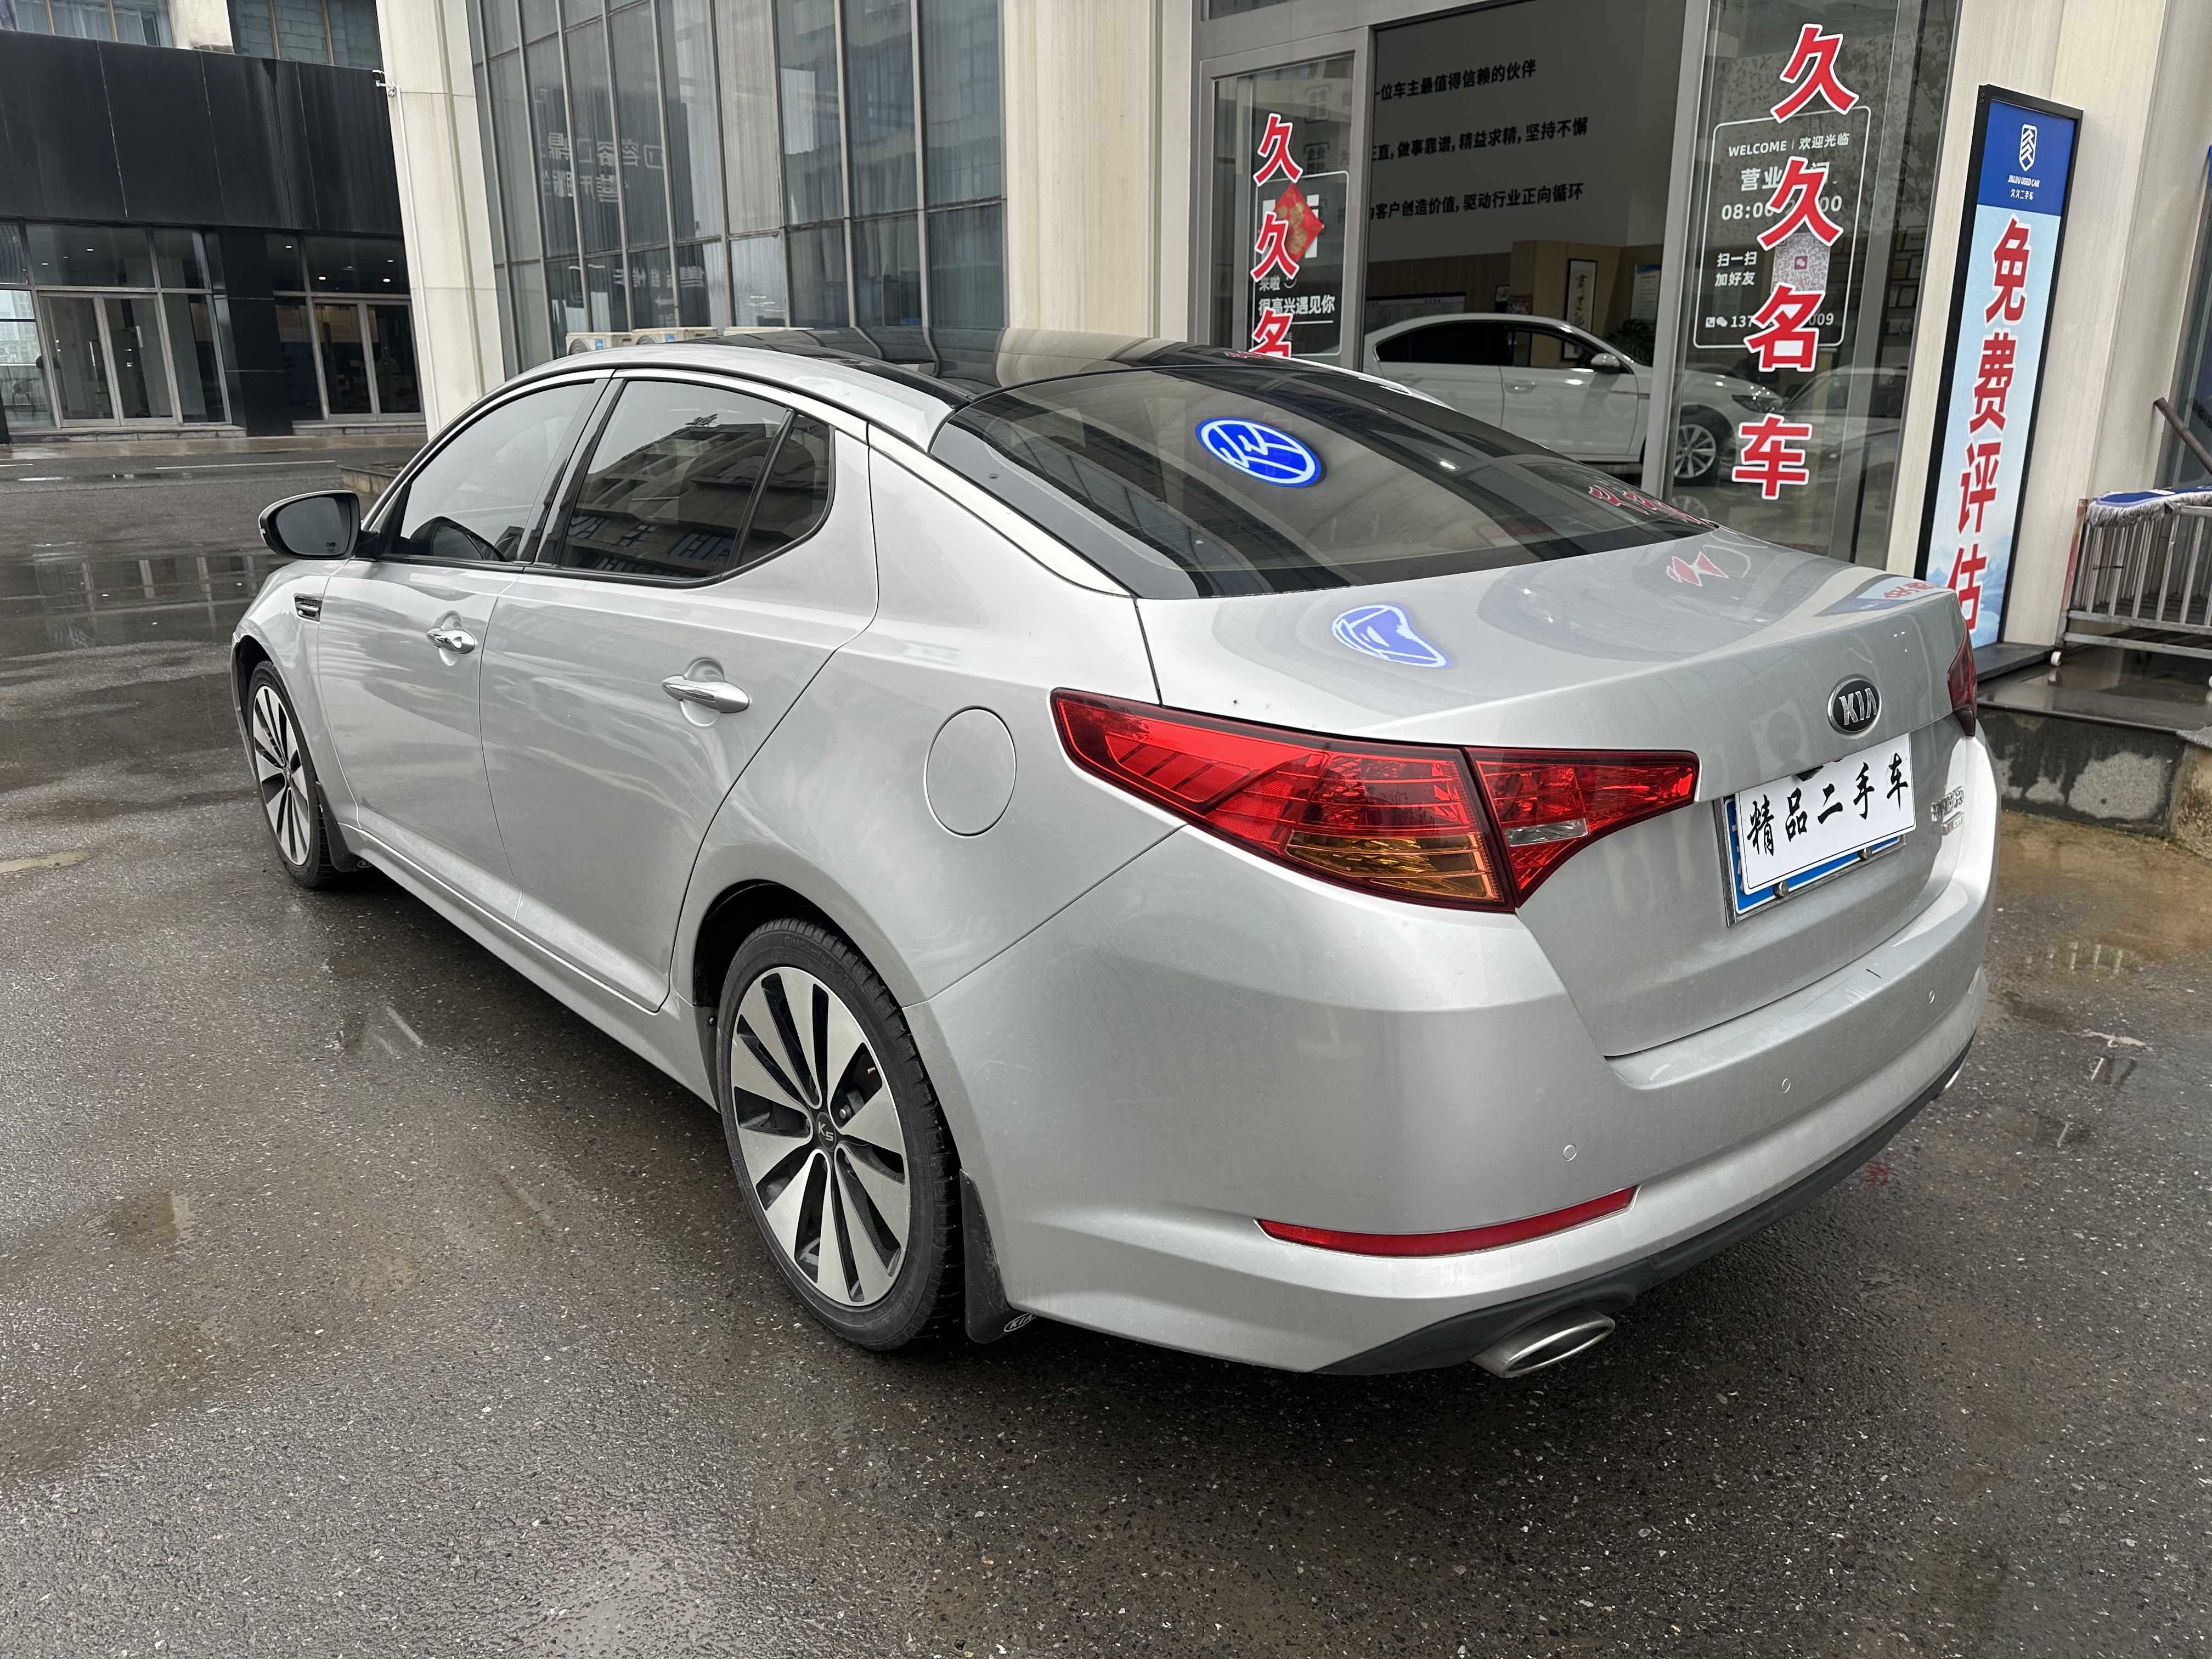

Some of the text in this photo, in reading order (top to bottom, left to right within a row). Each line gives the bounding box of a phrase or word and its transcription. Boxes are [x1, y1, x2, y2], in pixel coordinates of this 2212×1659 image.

[1729, 140, 1787, 157] WELCOME
[1798, 132, 1850, 150] 欢迎光临
[2032, 179, 2040, 187] CAR
[1717, 251, 1757, 267] 扫一扫
[1733, 24, 1859, 500] 久久名车
[1715, 272, 1756, 287] 加好友
[1258, 294, 1335, 317] 很高兴遇见你
[1947, 213, 2032, 634] 免费评估
[1839, 687, 1877, 725] KIA
[1747, 752, 1908, 856] 精品二手车
[818, 1121, 834, 1142] K5
